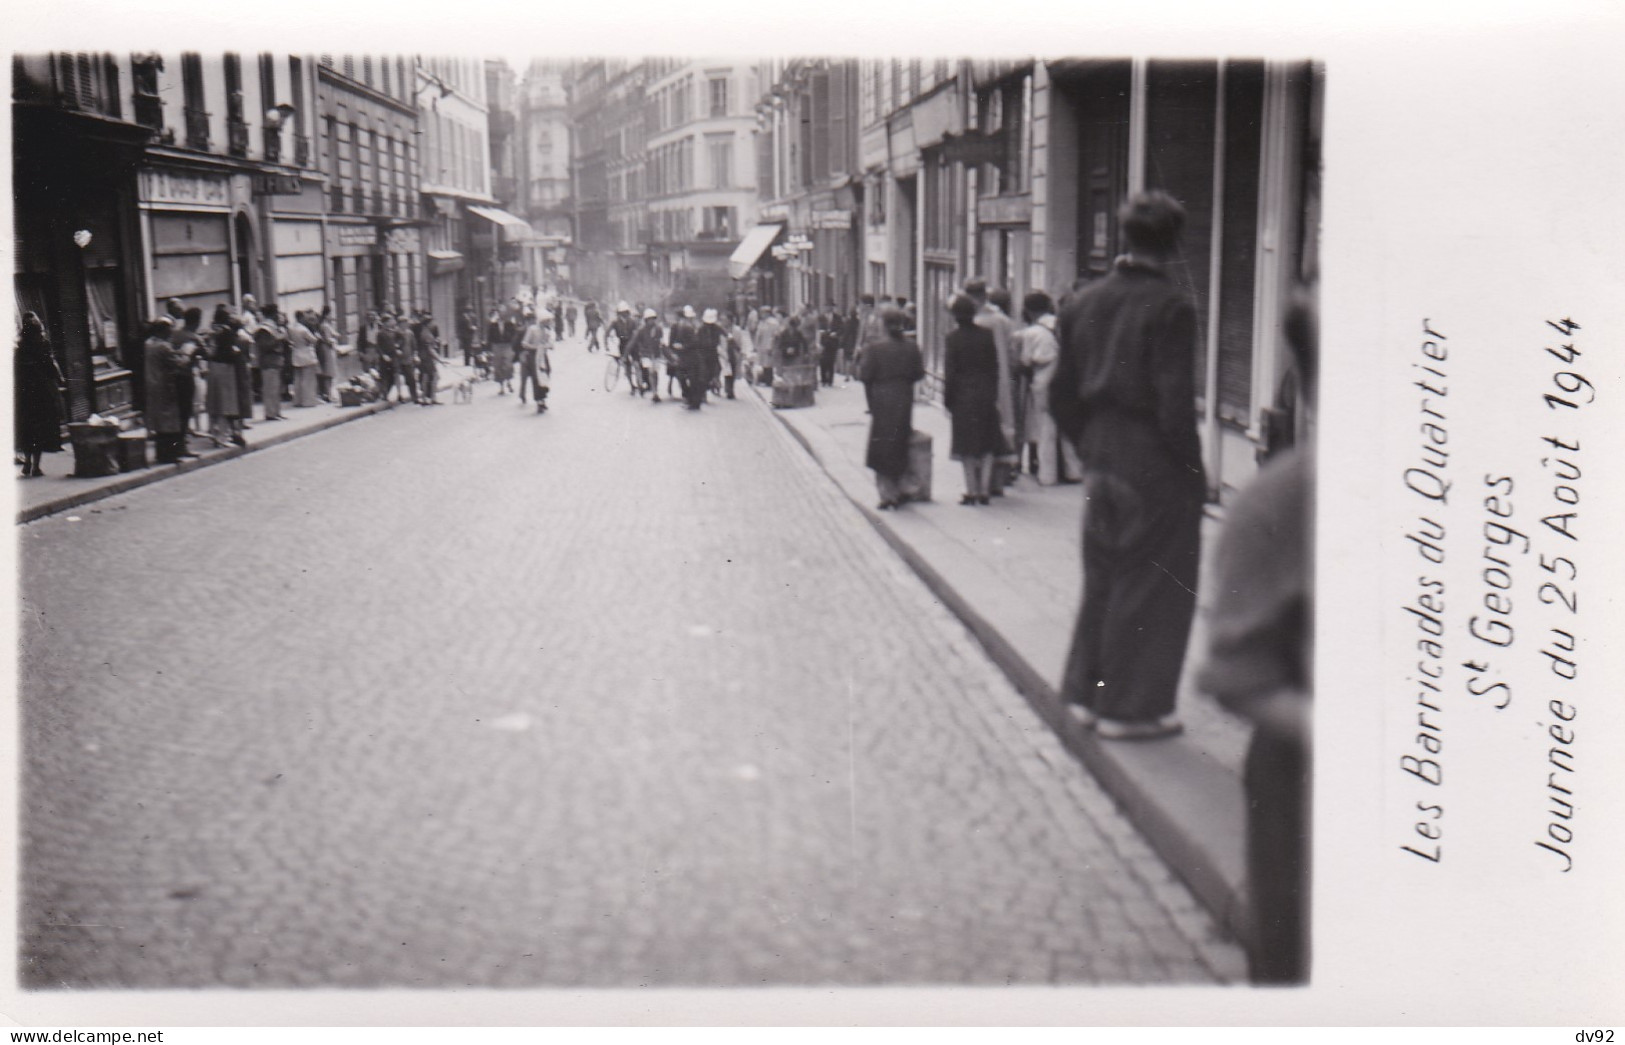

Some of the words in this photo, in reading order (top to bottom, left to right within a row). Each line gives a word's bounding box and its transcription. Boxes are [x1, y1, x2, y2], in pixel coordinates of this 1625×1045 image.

[1544, 317, 1595, 409] 1944
[1405, 317, 1451, 504] Quartier
[1541, 436, 1580, 540] Août
[1405, 517, 1446, 563] du
[1469, 474, 1530, 647] Georges
[1538, 556, 1577, 614] 25
[1401, 577, 1444, 786] Barricades
[1462, 660, 1512, 709] St
[1541, 628, 1576, 679] du
[1535, 701, 1576, 872] Journée
[1400, 803, 1443, 864] Les
